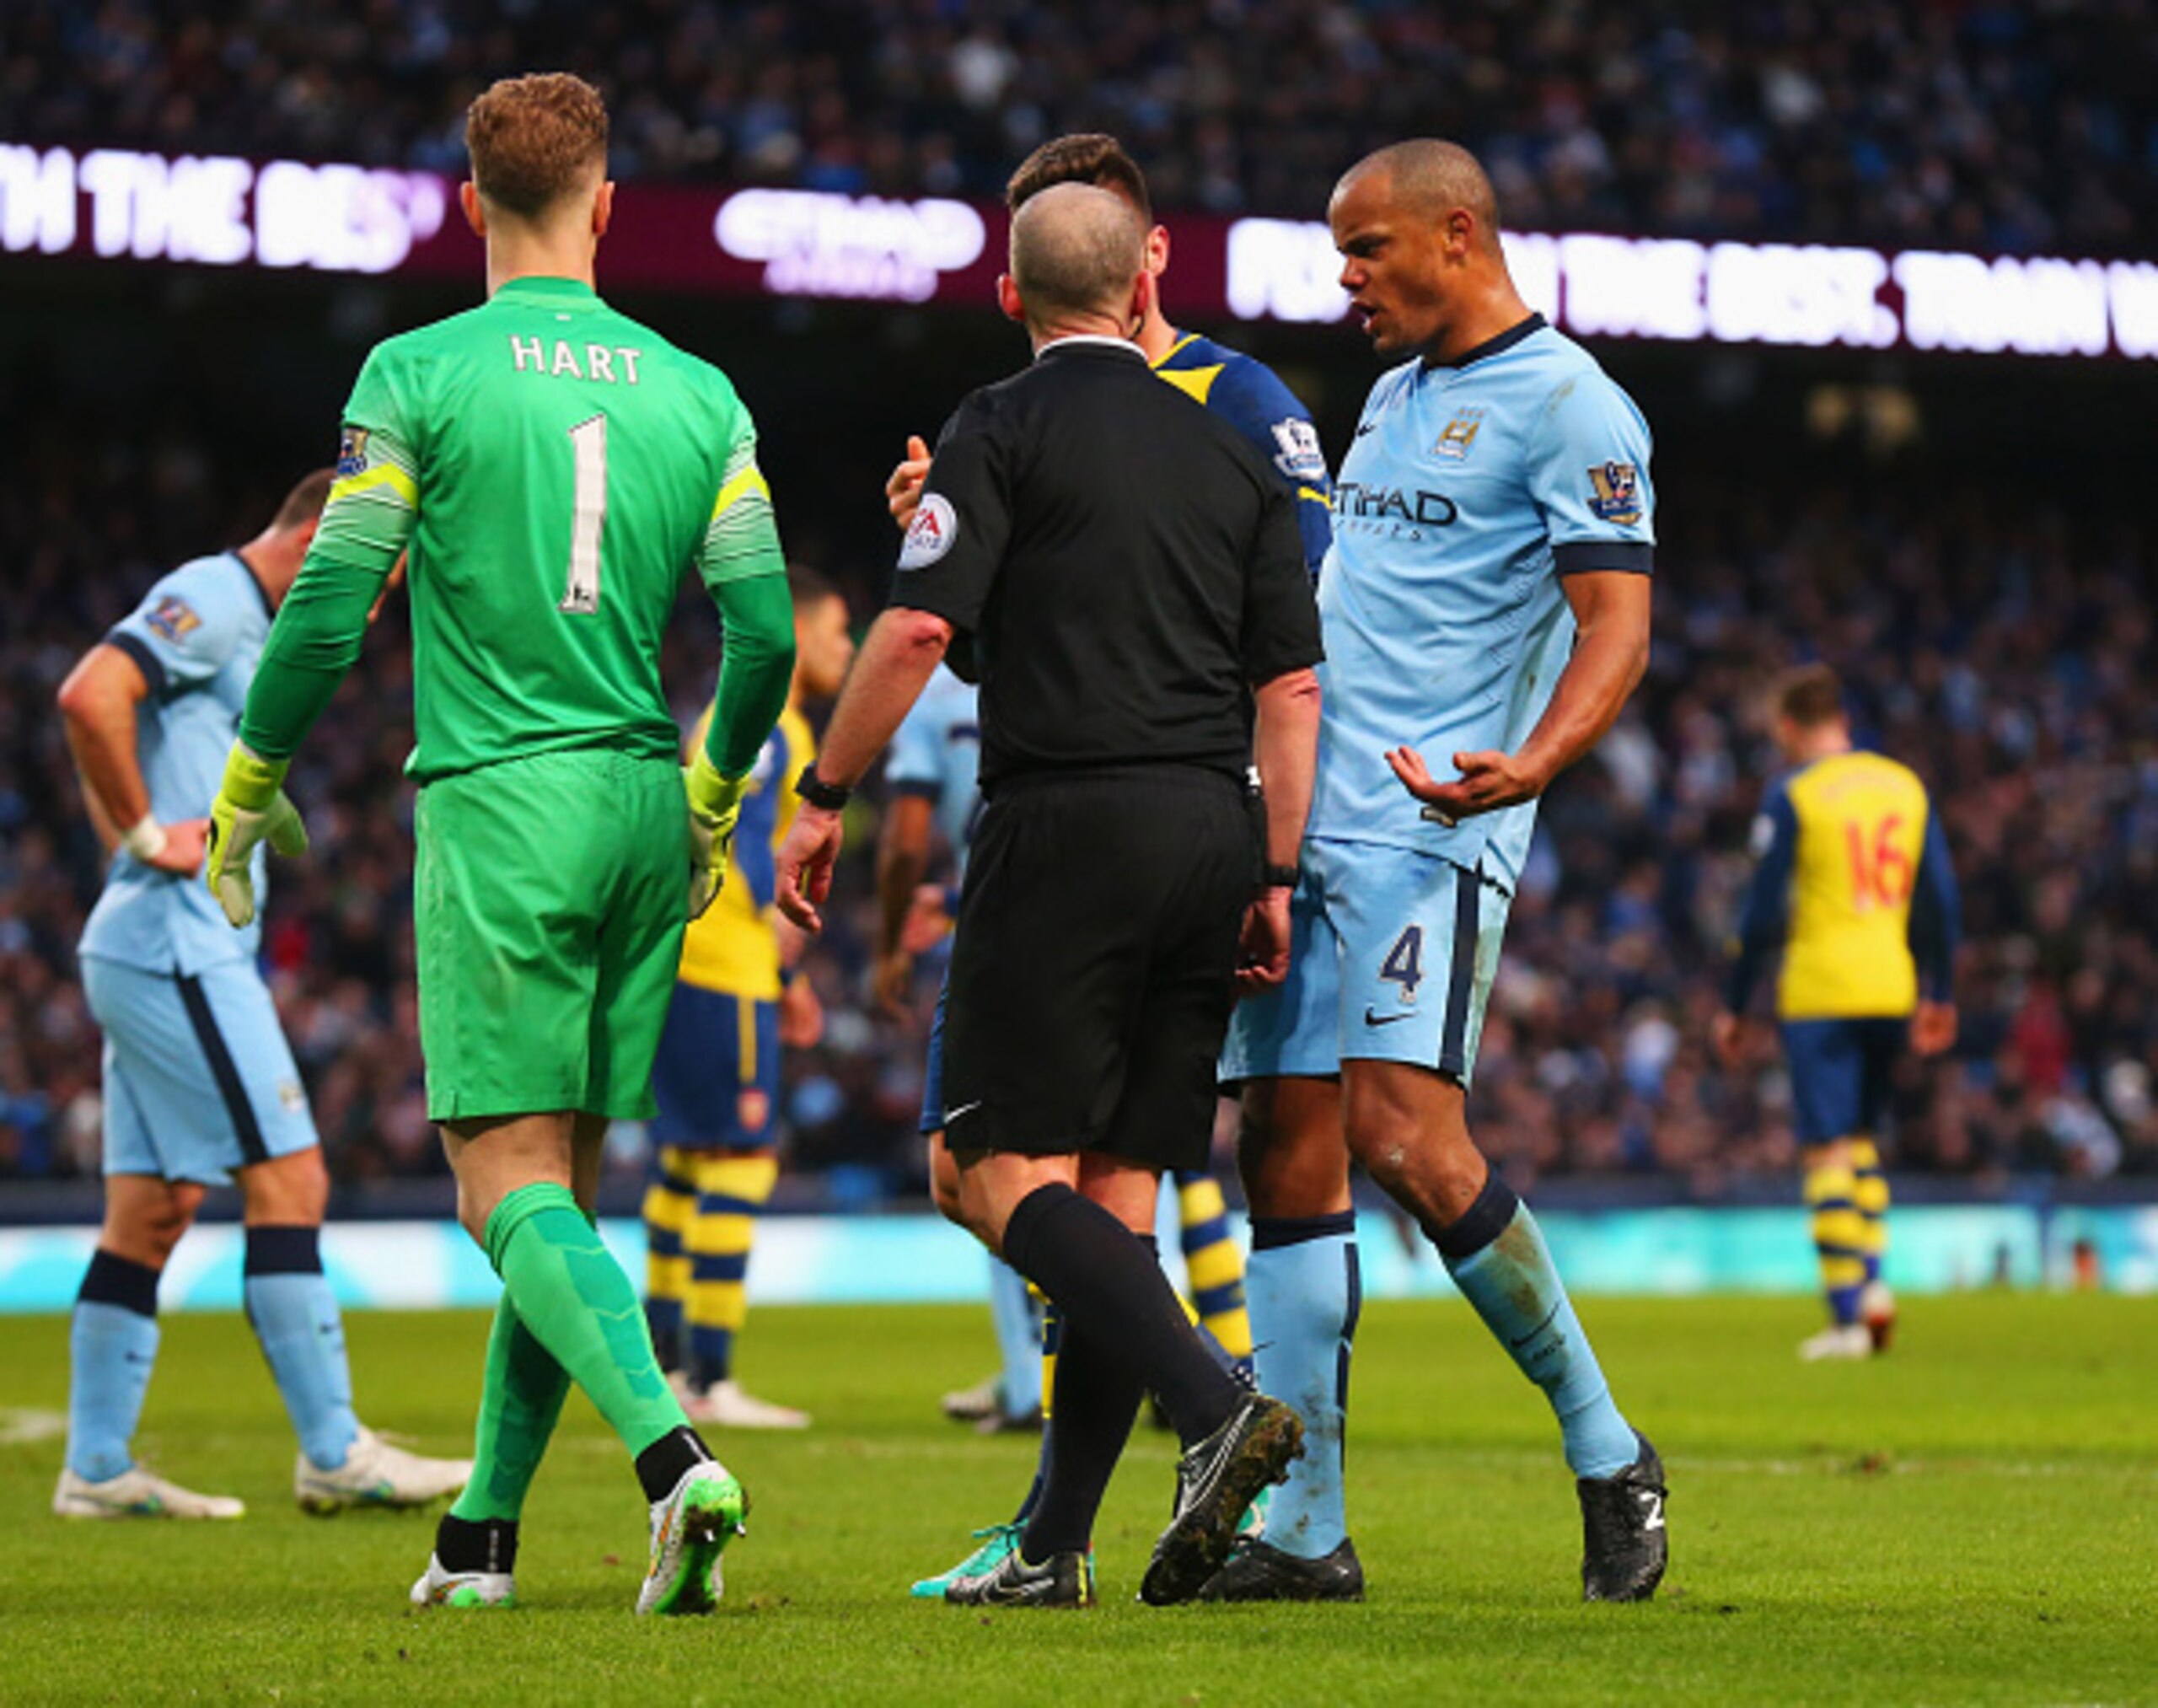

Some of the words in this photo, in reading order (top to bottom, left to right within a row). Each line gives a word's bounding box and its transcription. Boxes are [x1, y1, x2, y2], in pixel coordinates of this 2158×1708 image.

[507, 333, 642, 385] HART
[558, 412, 608, 613] 1
[1334, 483, 1457, 527] TIHAD
[1845, 814, 1912, 911] 16
[1377, 923, 1425, 1004] 4
